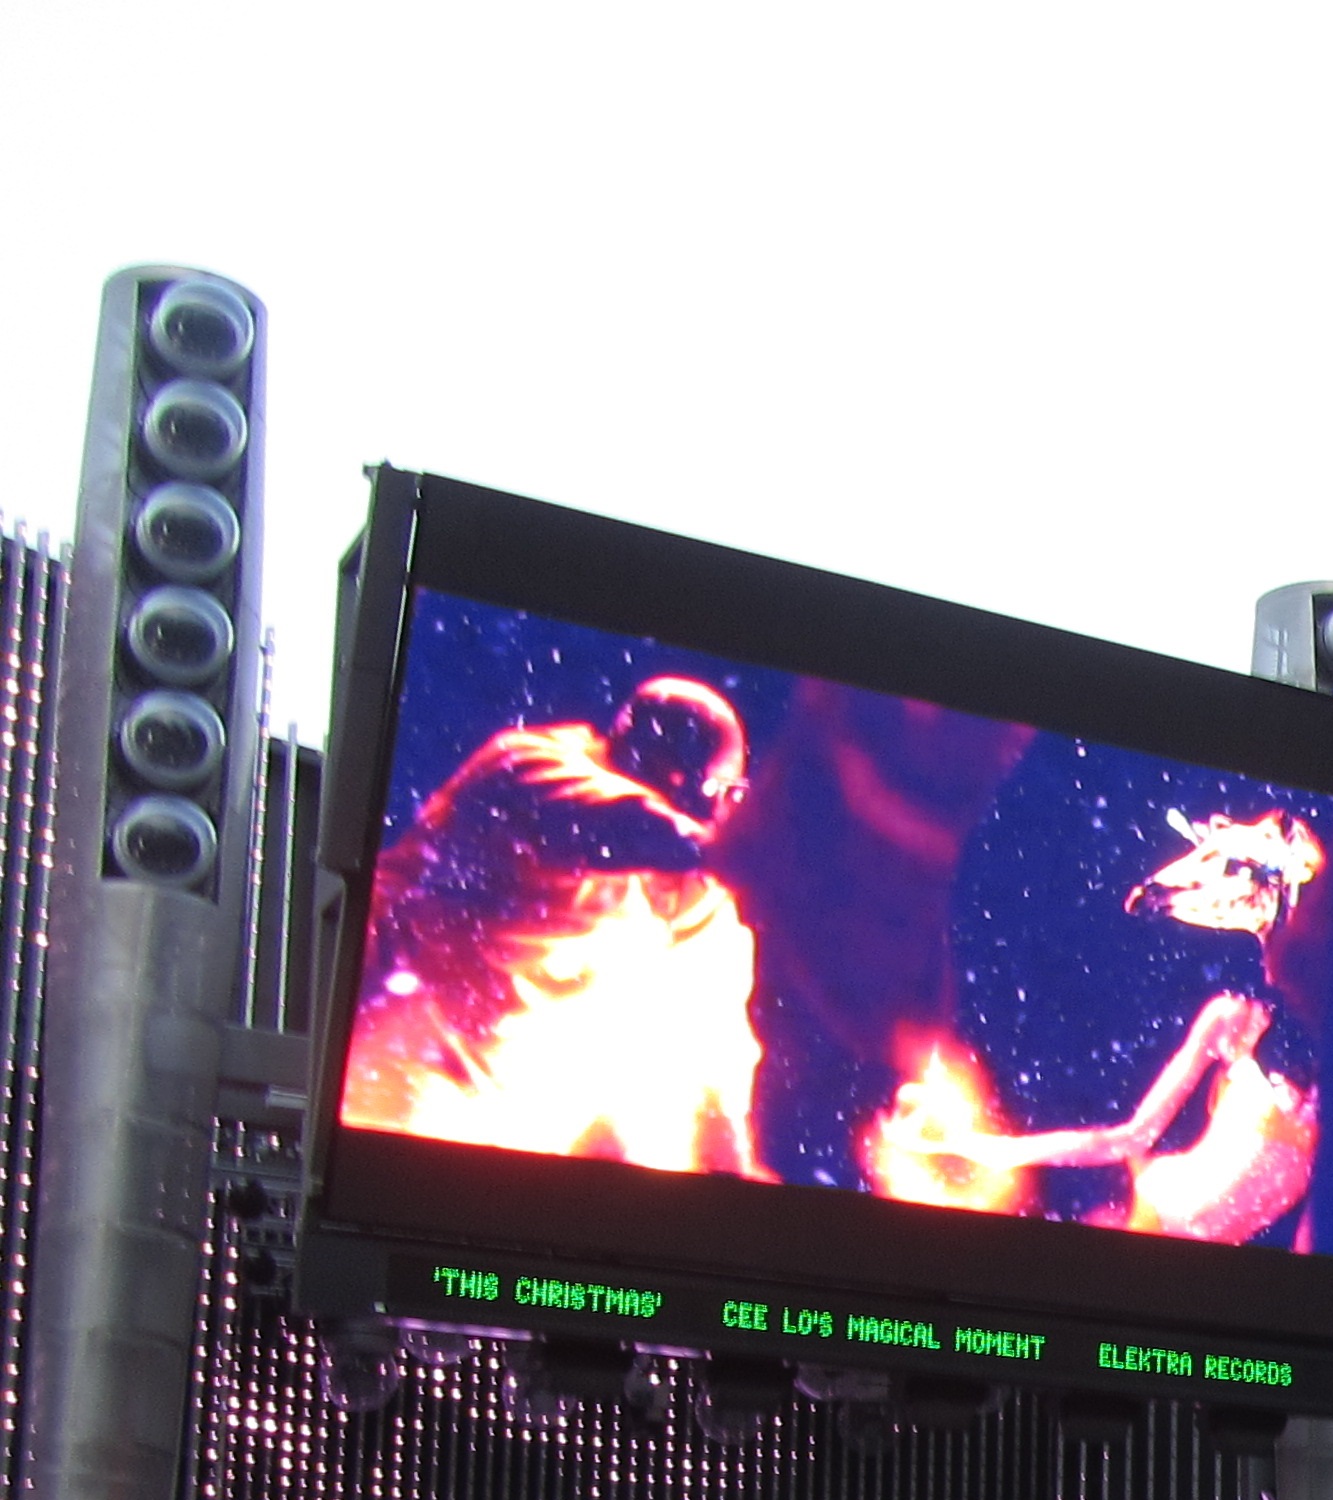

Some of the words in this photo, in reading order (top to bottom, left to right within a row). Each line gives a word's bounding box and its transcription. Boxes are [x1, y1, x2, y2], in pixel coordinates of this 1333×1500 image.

[434, 1266, 500, 1301] 'THIS
[514, 1276, 664, 1319] CHRISTMAS'
[722, 1300, 769, 1332] CEE
[781, 1306, 834, 1338] LO'S
[846, 1313, 943, 1350] MAGICAL
[954, 1326, 1047, 1361] MOMENT
[1098, 1342, 1194, 1377] ELEKTRA
[1204, 1353, 1294, 1388] RECORDS
